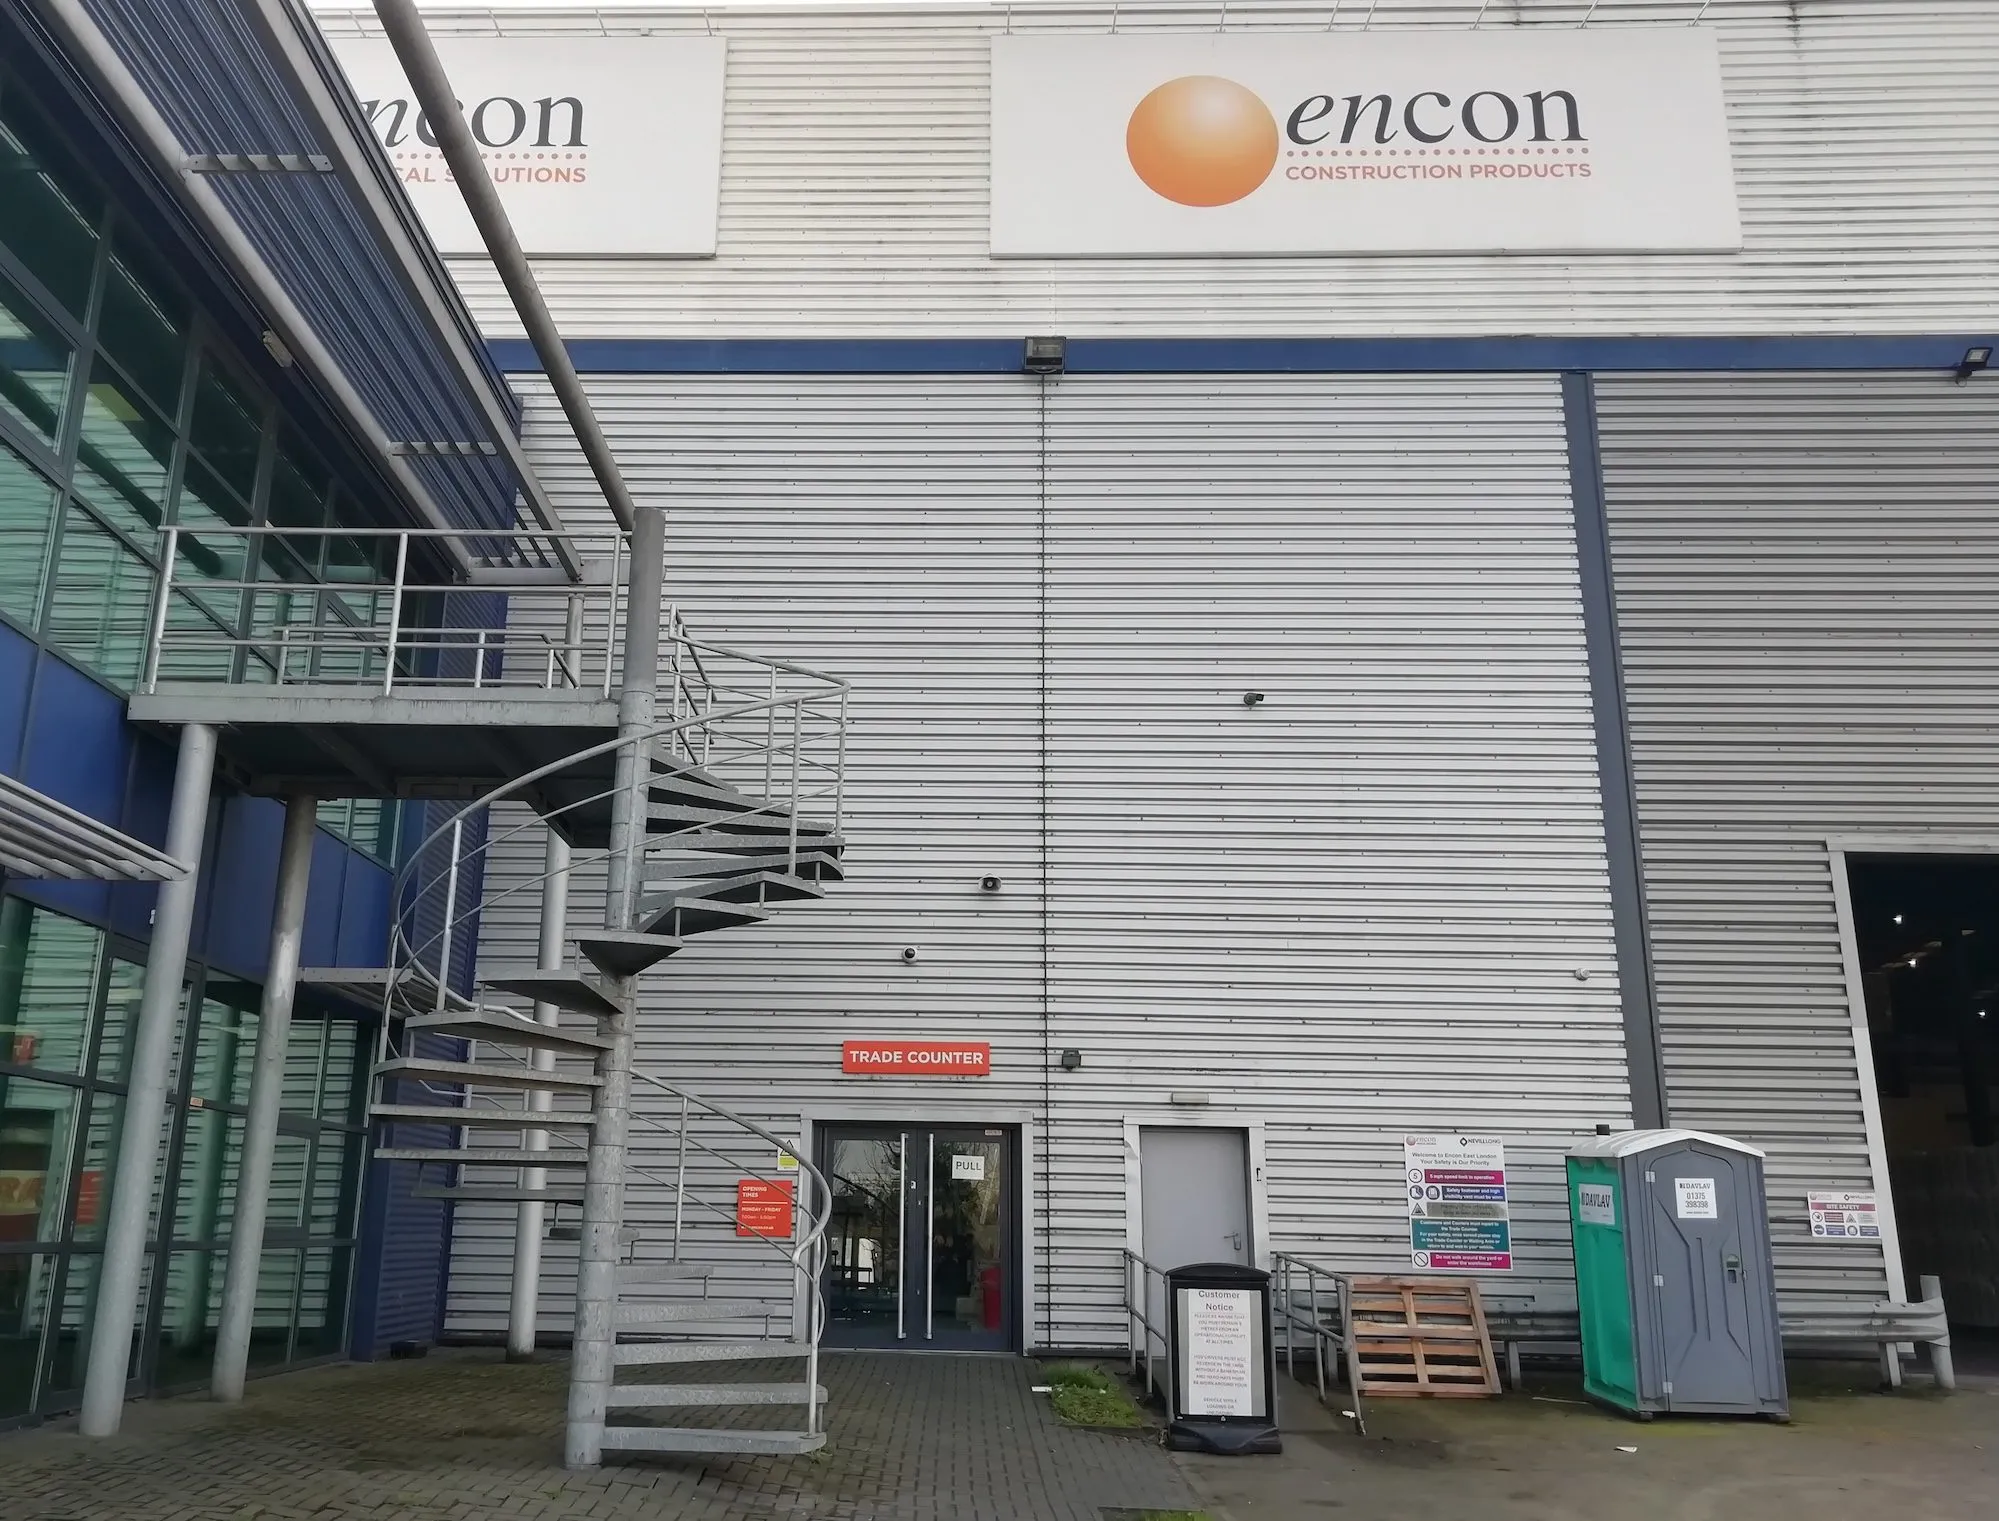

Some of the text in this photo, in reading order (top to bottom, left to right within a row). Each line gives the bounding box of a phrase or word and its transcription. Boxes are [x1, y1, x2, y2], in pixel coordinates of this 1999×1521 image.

[1286, 90, 1588, 145] encon
[1285, 162, 1592, 181] CONSTRUCTION PRODUCTS
[850, 1050, 983, 1065] TRADE COUNTER
[956, 1161, 982, 1170] PULL
[1687, 1192, 1706, 1200] 01375
[1199, 1290, 1240, 1298] Customer
[1206, 1303, 1233, 1311] Notice
